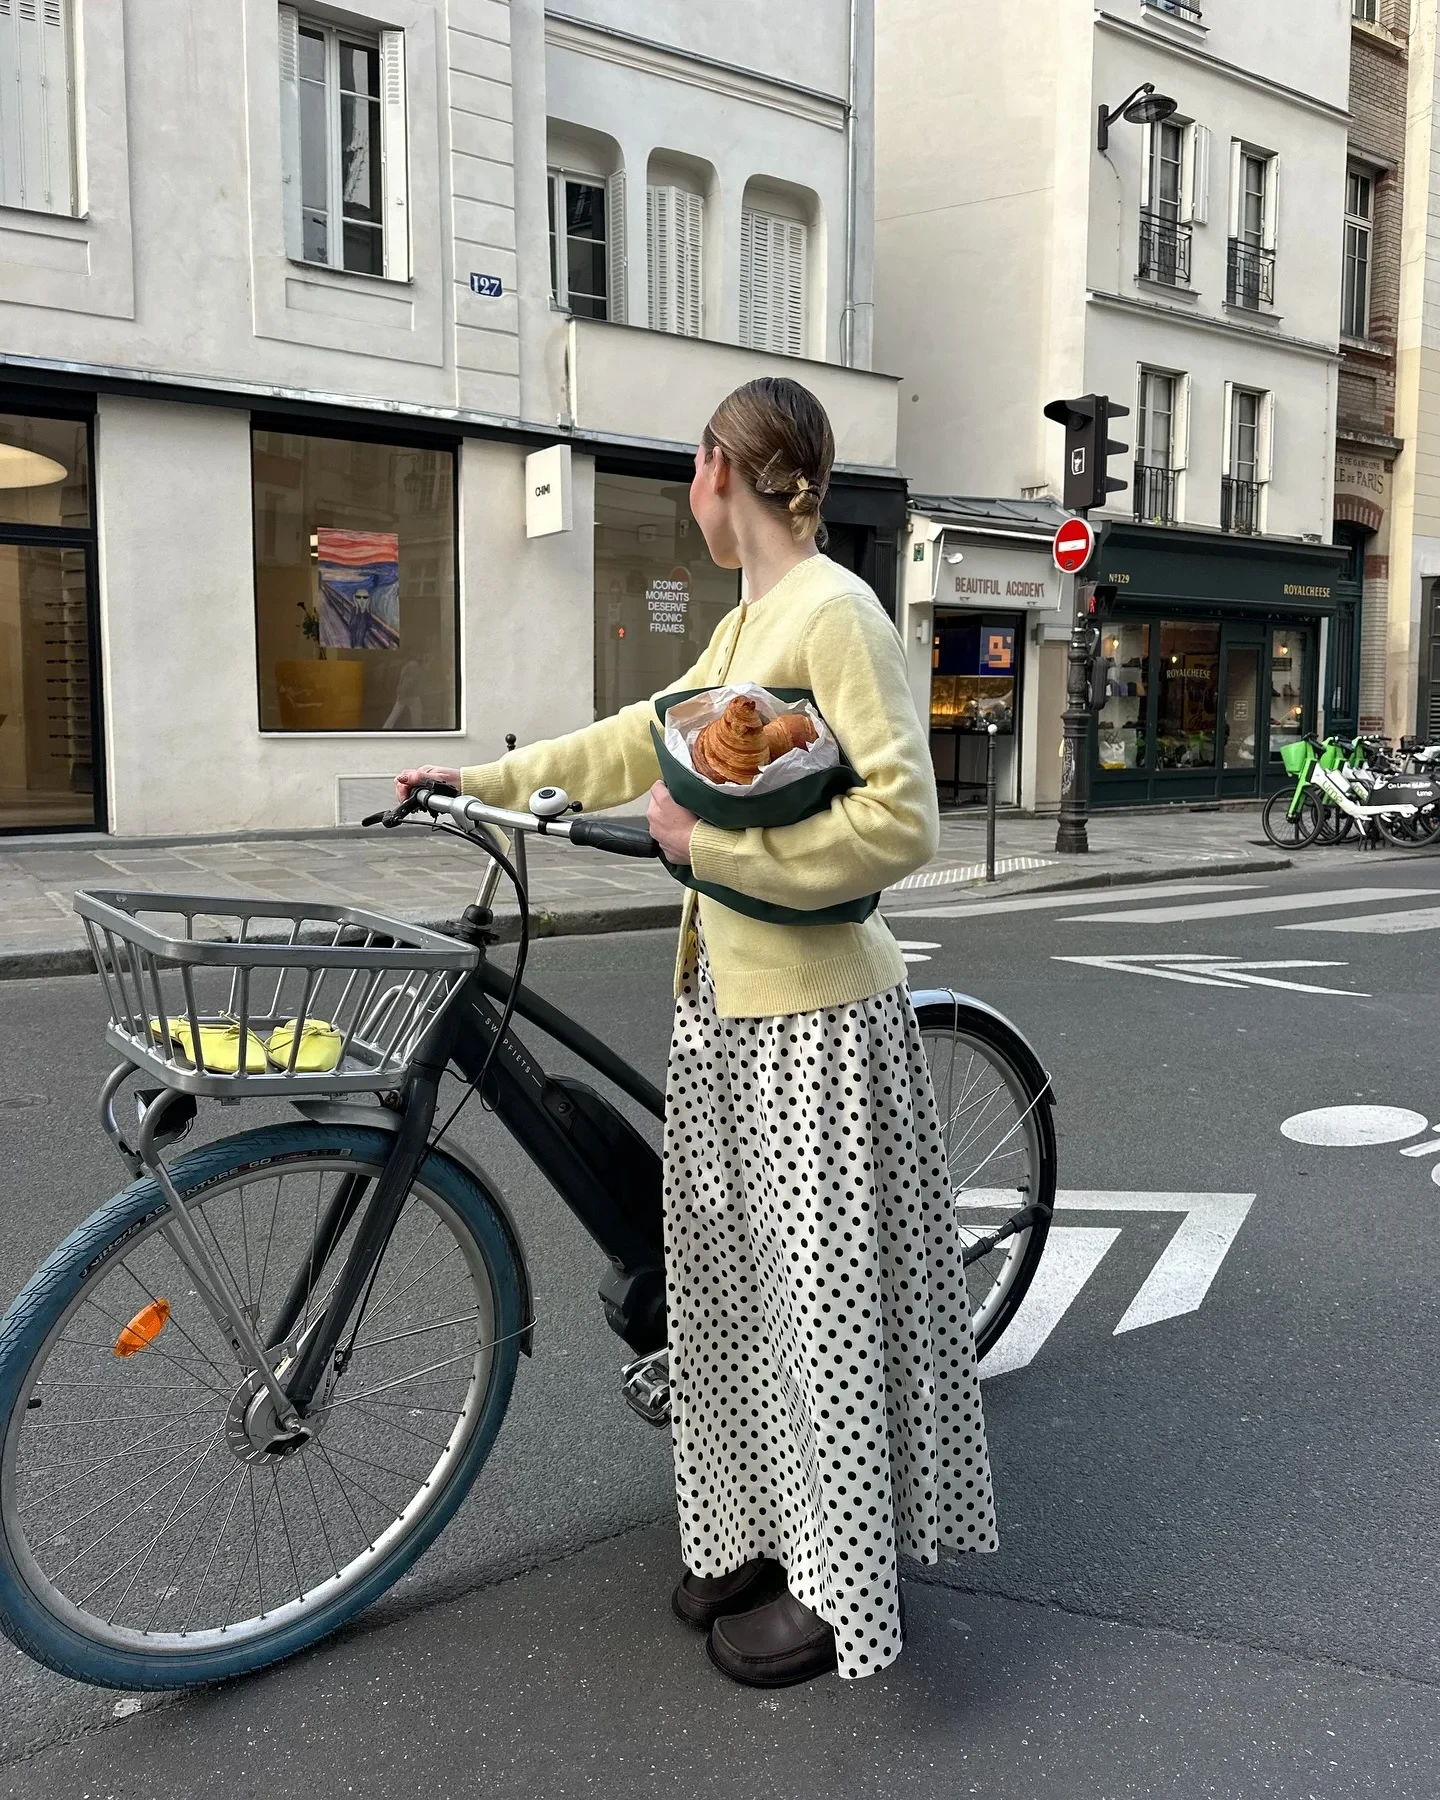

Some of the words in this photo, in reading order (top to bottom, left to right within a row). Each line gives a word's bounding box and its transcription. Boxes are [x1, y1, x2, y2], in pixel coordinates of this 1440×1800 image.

[472, 275, 500, 296] 127
[1357, 471, 1384, 494] PARIS
[652, 580, 683, 591] ICONIC
[955, 576, 1001, 596] BEAUTIFUL
[1005, 581, 1045, 598] ACCIDENT
[1283, 584, 1331, 598] ROYALCHEESE
[645, 591, 690, 602] MOMENTS
[648, 601, 687, 612] DESERVE
[652, 612, 683, 623] ICONIC
[650, 623, 685, 634] FRAMES
[1166, 668, 1211, 679] ROYALCHEESE
[485, 1017, 531, 1073] SWPFIETS
[145, 1166, 240, 1222] ADENTURE
